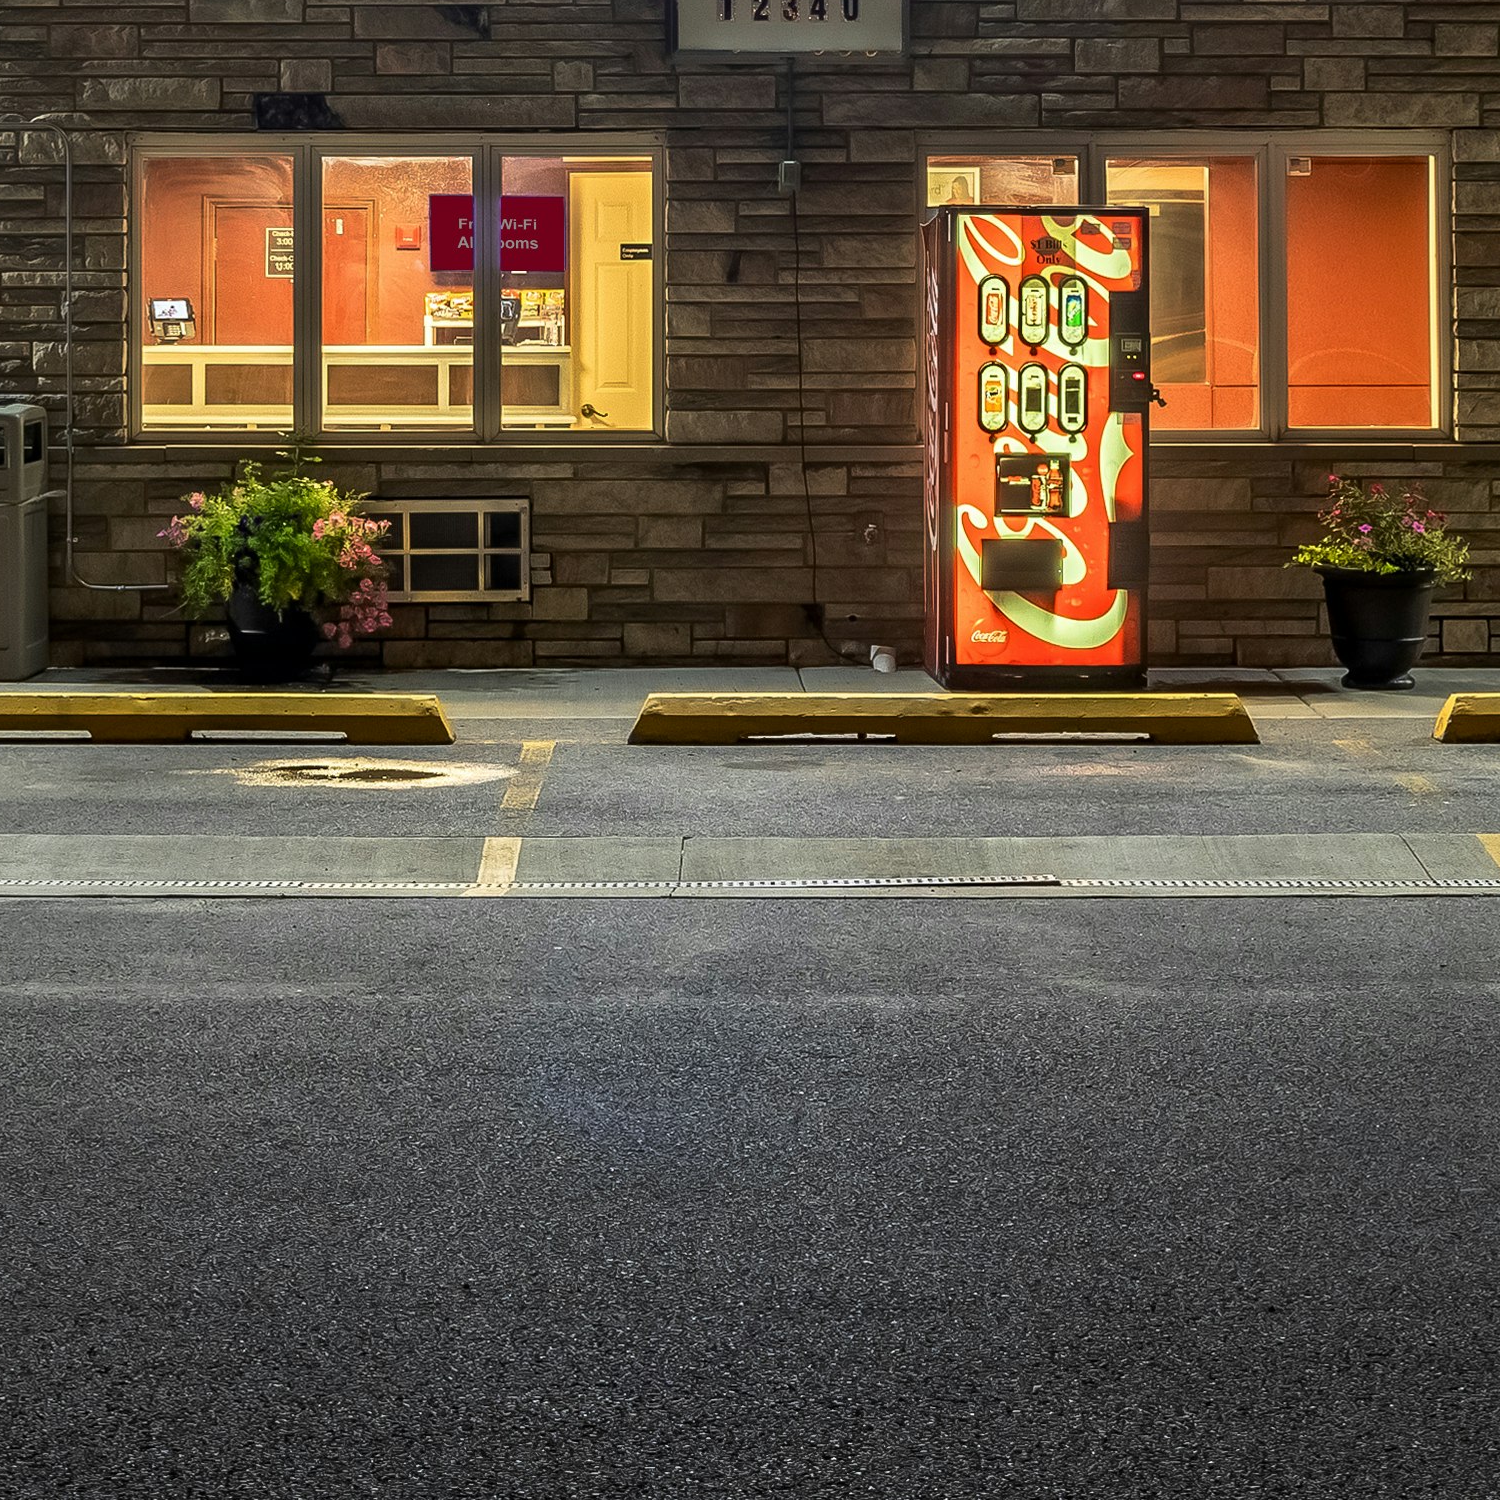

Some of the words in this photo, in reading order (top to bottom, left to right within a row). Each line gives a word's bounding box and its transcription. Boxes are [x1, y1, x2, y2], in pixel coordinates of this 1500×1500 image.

[458, 218, 473, 230] Fr
[500, 219, 538, 231] Wi-Fi
[1037, 254, 1061, 265] Only
[971, 630, 1008, 643] Coca-Cola
